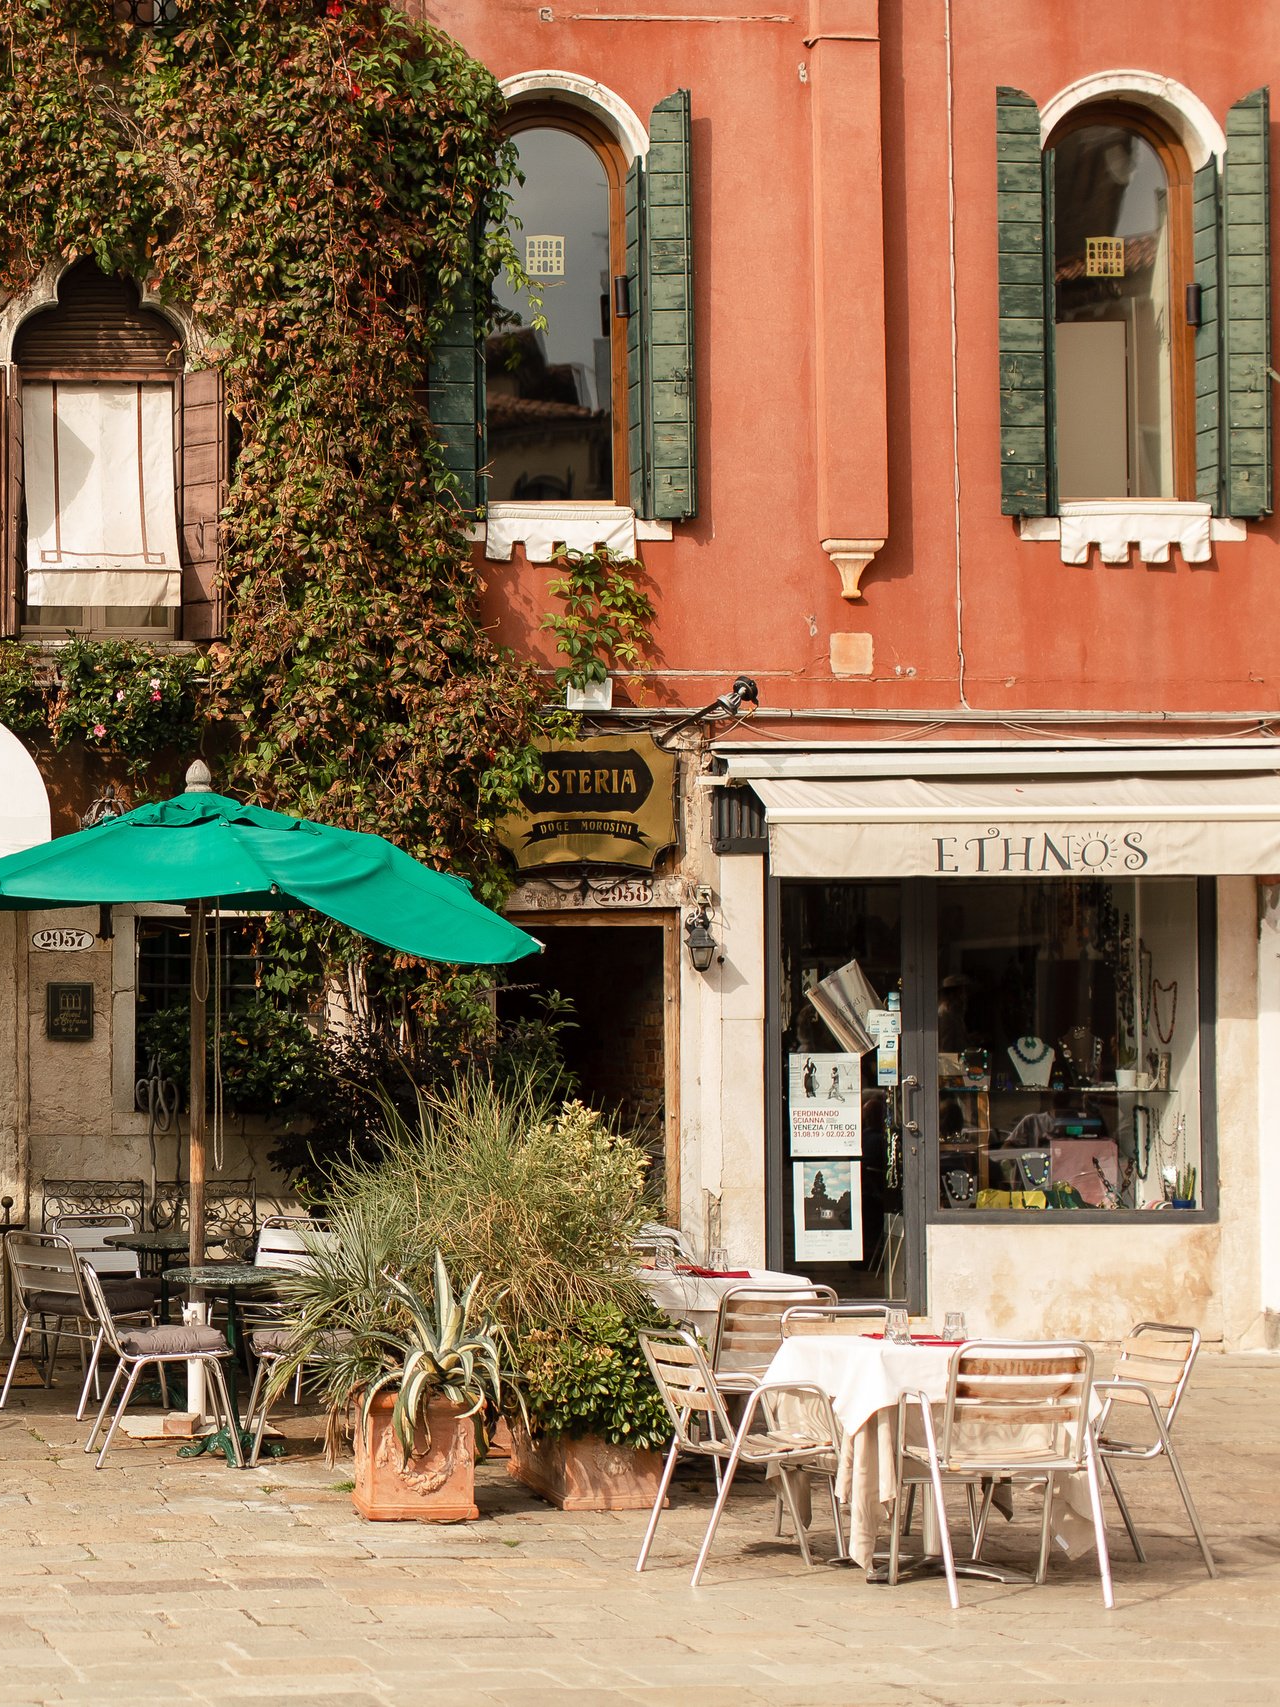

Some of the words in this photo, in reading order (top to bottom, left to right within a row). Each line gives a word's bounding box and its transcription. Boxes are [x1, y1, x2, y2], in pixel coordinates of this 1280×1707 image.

[531, 769, 637, 794] OSTERIA
[540, 821, 569, 835] DOGE
[581, 820, 632, 835] MOROSINI
[931, 827, 1149, 872] ETHNOS
[599, 886, 649, 902] 2958
[40, 931, 86, 947] 2957
[59, 1011, 81, 1019] Hotel
